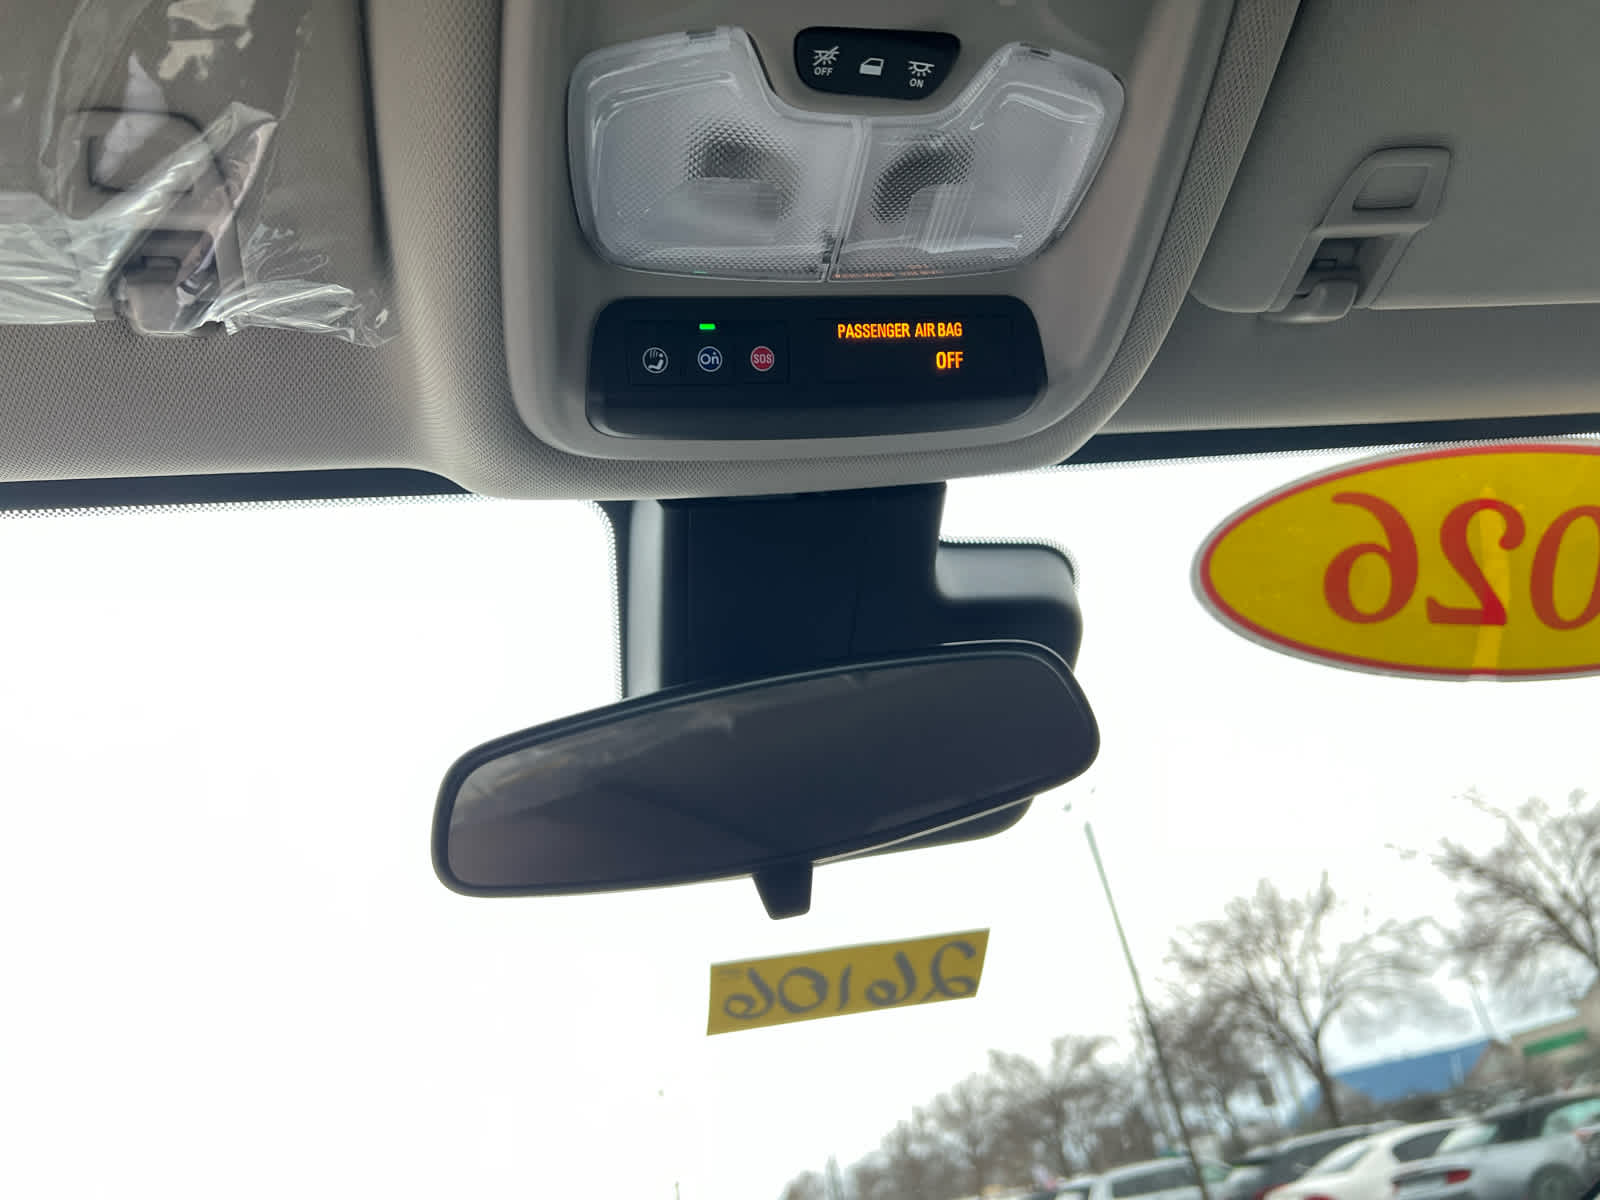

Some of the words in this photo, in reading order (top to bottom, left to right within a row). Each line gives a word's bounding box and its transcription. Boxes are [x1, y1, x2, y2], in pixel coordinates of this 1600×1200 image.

[814, 67, 833, 76] OFF
[909, 79, 924, 88] ON
[837, 322, 911, 339] PASSENGER
[914, 322, 936, 338] AIR
[937, 321, 963, 337] BAG
[753, 353, 772, 364] SOS
[935, 351, 964, 370] OFF
